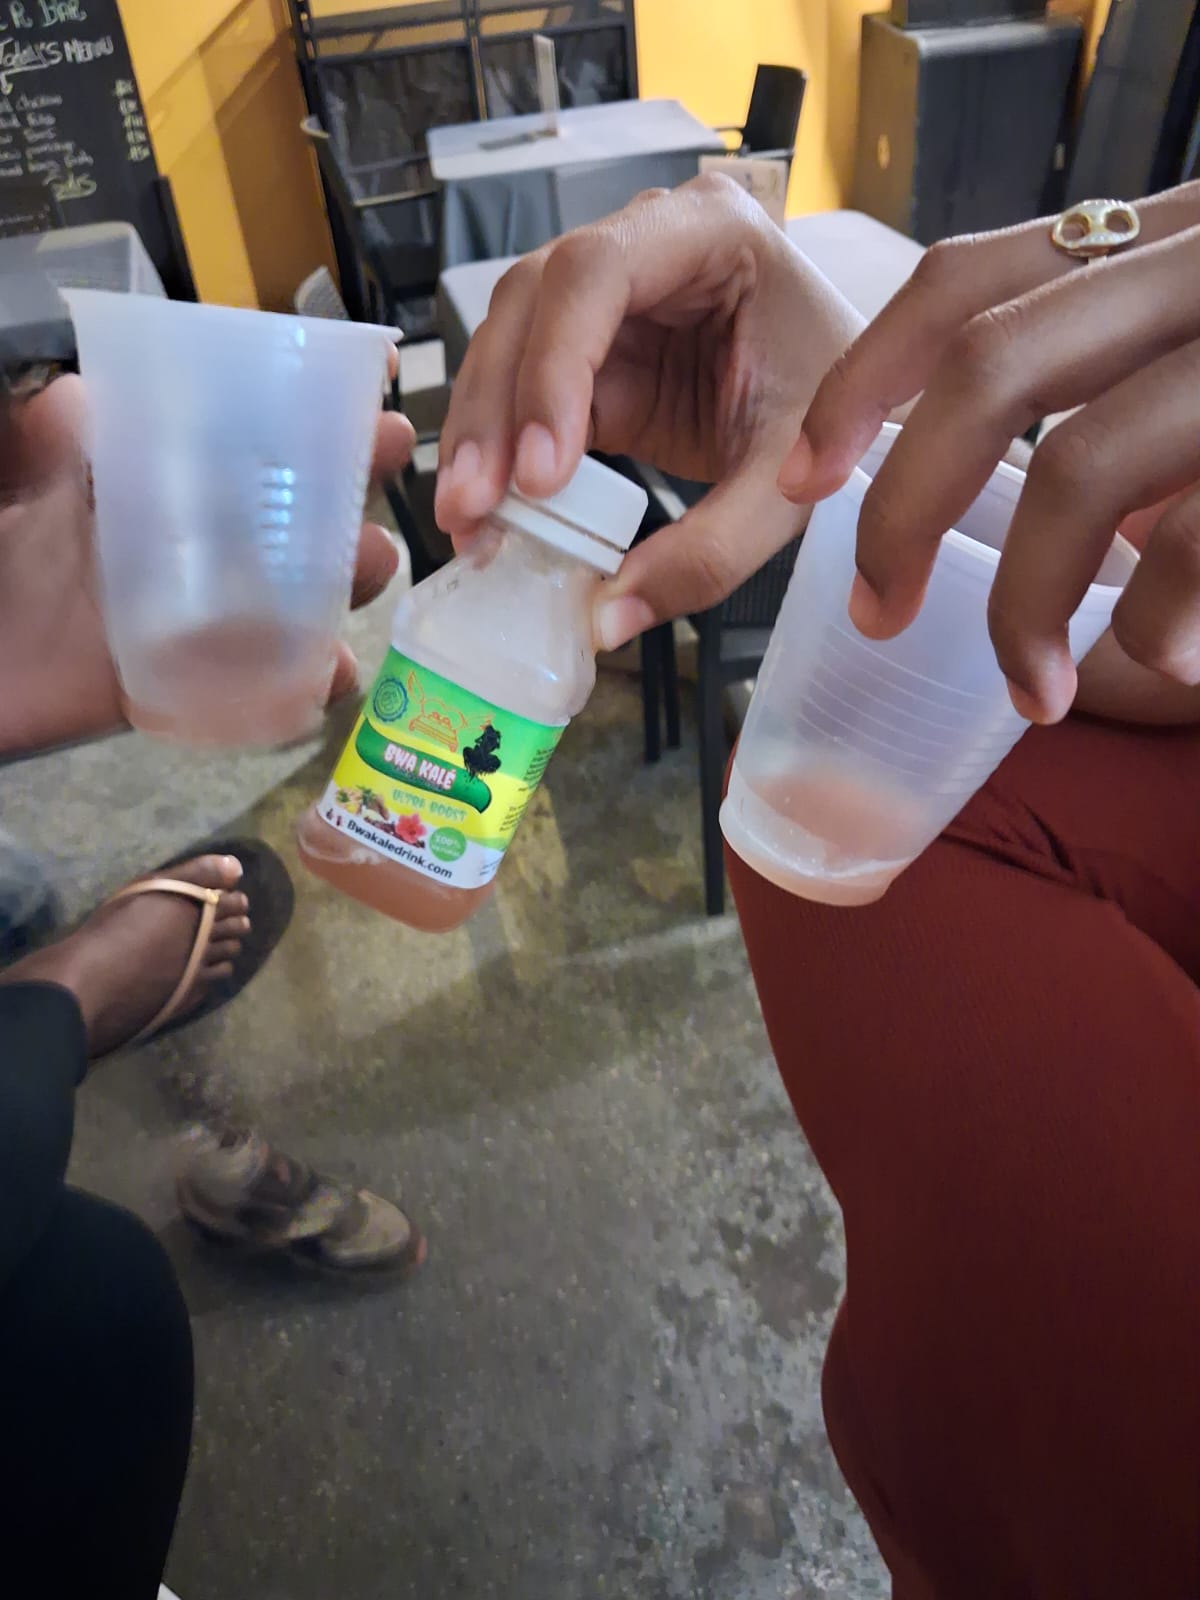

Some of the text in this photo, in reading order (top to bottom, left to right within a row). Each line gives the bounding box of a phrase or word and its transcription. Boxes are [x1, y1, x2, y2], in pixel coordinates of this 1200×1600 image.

[384, 743, 416, 772] BWA
[418, 761, 457, 790] KALÉ
[429, 800, 468, 822] BOOST
[346, 818, 453, 879] Bwakaledrink.com
